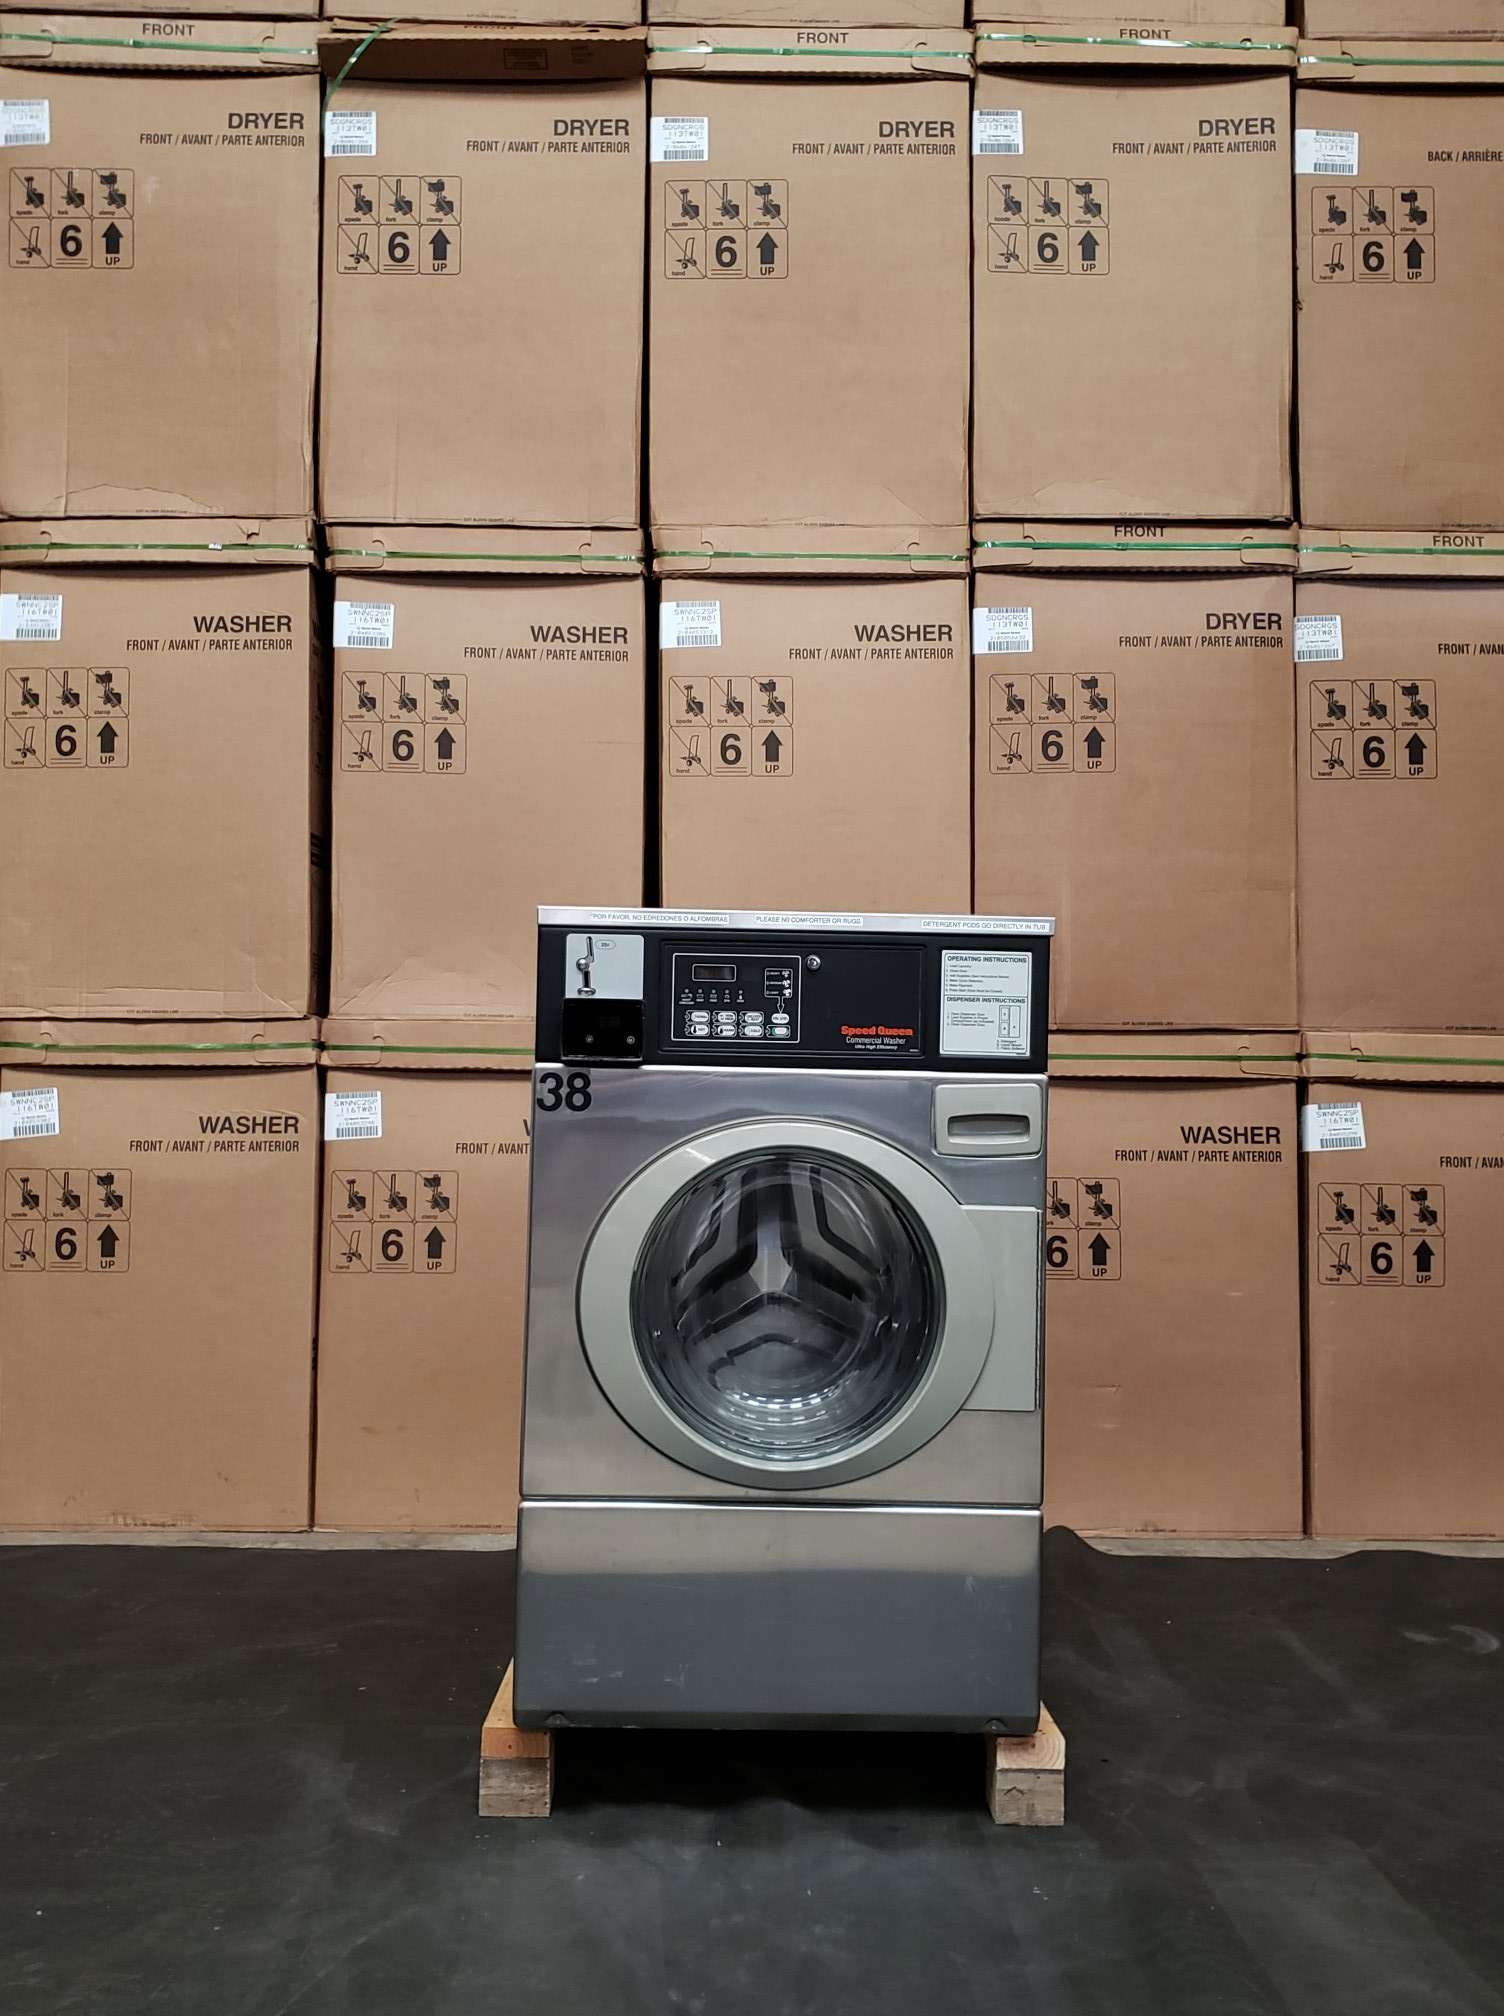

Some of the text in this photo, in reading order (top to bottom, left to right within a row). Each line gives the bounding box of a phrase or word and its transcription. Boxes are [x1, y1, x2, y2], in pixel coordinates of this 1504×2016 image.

[142, 23, 195, 36] FRONT
[797, 28, 849, 43] FRONT
[1119, 28, 1171, 40] FRONT
[228, 113, 304, 130] DRYER
[554, 119, 629, 137] DRYER
[1199, 117, 1276, 137] DRYER
[879, 121, 955, 138] DRYER
[140, 133, 304, 147] FRONT AVANT PARTE ANTERIOR
[467, 140, 632, 153] FRONT AVANT PARTE ANTERIOR
[793, 143, 955, 156] FRONT AVANT PARTE ANTERIOR
[1113, 140, 1276, 154] FRONT AVANT PARTE ANTERIOR
[1428, 149, 1503, 162] BACK ARRIÈRE
[60, 224, 82, 256] 6
[388, 231, 410, 263] 6
[715, 235, 737, 267] 6
[1037, 232, 1059, 264] 6
[105, 257, 120, 266] UP
[1363, 241, 1385, 272] 6
[432, 263, 448, 272] UP
[760, 267, 775, 276] UP
[1082, 263, 1096, 272] UP
[1407, 271, 1422, 280] UP
[1114, 524, 1166, 537] FRONT
[1432, 536, 1484, 549] FRONT
[193, 615, 292, 633] WASHER
[1206, 612, 1282, 631] DRYER
[530, 625, 628, 643] WASHER
[854, 624, 953, 642] WASHER
[127, 638, 292, 651] FRONT AVANT PARTE ANTERIOR
[1119, 635, 1283, 648] FRONT AVANT PARTE ANTERIOR
[464, 647, 628, 662] FRONT AVANT PARTE ANTERIOR
[789, 648, 953, 660] FRONT AVANT PARTE ANTERIOR
[1438, 643, 1470, 655] FRONT
[55, 724, 77, 757] 6
[392, 729, 414, 761] 6
[1042, 730, 1064, 762] 6
[720, 733, 742, 765] 6
[1363, 736, 1385, 768] 6
[100, 756, 115, 765] UP
[437, 762, 452, 771] UP
[1087, 761, 1102, 769] UP
[765, 765, 780, 773] UP
[1409, 767, 1423, 776] UP
[922, 920, 961, 928] DETERGENT
[841, 1025, 913, 1036] Speed Queen
[846, 1036, 907, 1045] Commercial Washer
[537, 1072, 592, 1112] 38
[199, 1115, 299, 1134] WASHER
[1180, 1126, 1280, 1144] WASHER
[130, 1140, 299, 1152] FRONT AVANT PARTE ANTERIOR
[456, 1142, 530, 1154] FRONT AVANT
[1115, 1149, 1282, 1162] FRONT AVANT PARTE ANTERIOR
[1440, 1156, 1472, 1168] FRONT
[55, 1227, 77, 1260] 6
[382, 1229, 404, 1262] 6
[1047, 1235, 1069, 1268] 6
[100, 1260, 115, 1269] UP
[1371, 1242, 1393, 1275] 6
[427, 1262, 442, 1270] UP
[1092, 1268, 1107, 1276] UP
[1416, 1275, 1432, 1283] UP
